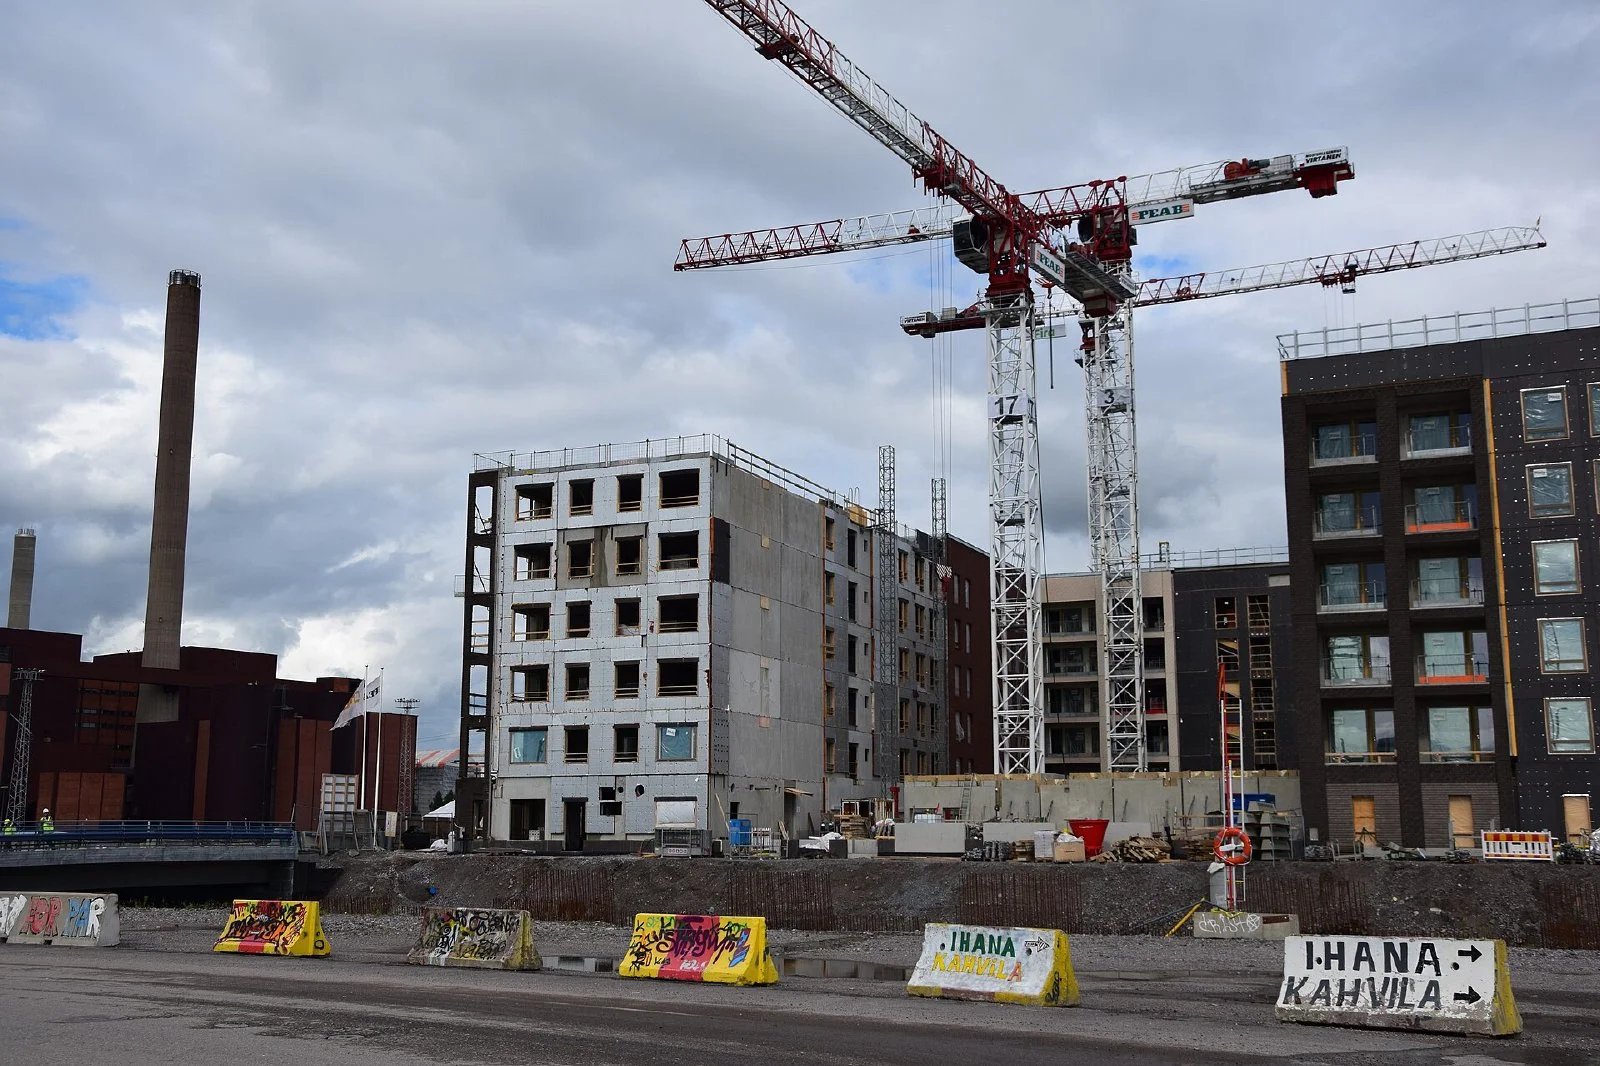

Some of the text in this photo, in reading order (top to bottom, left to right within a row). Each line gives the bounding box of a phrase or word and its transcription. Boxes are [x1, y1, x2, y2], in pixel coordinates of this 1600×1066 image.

[1139, 204, 1182, 219] PEAB
[1040, 252, 1060, 274] PEAB
[994, 395, 1018, 415] 17
[1104, 389, 1115, 404] 3
[61, 896, 106, 939] PAR
[950, 931, 1016, 958] IHANA
[1305, 941, 1442, 977] IHANA
[1283, 975, 1442, 1010] KAHVILA
